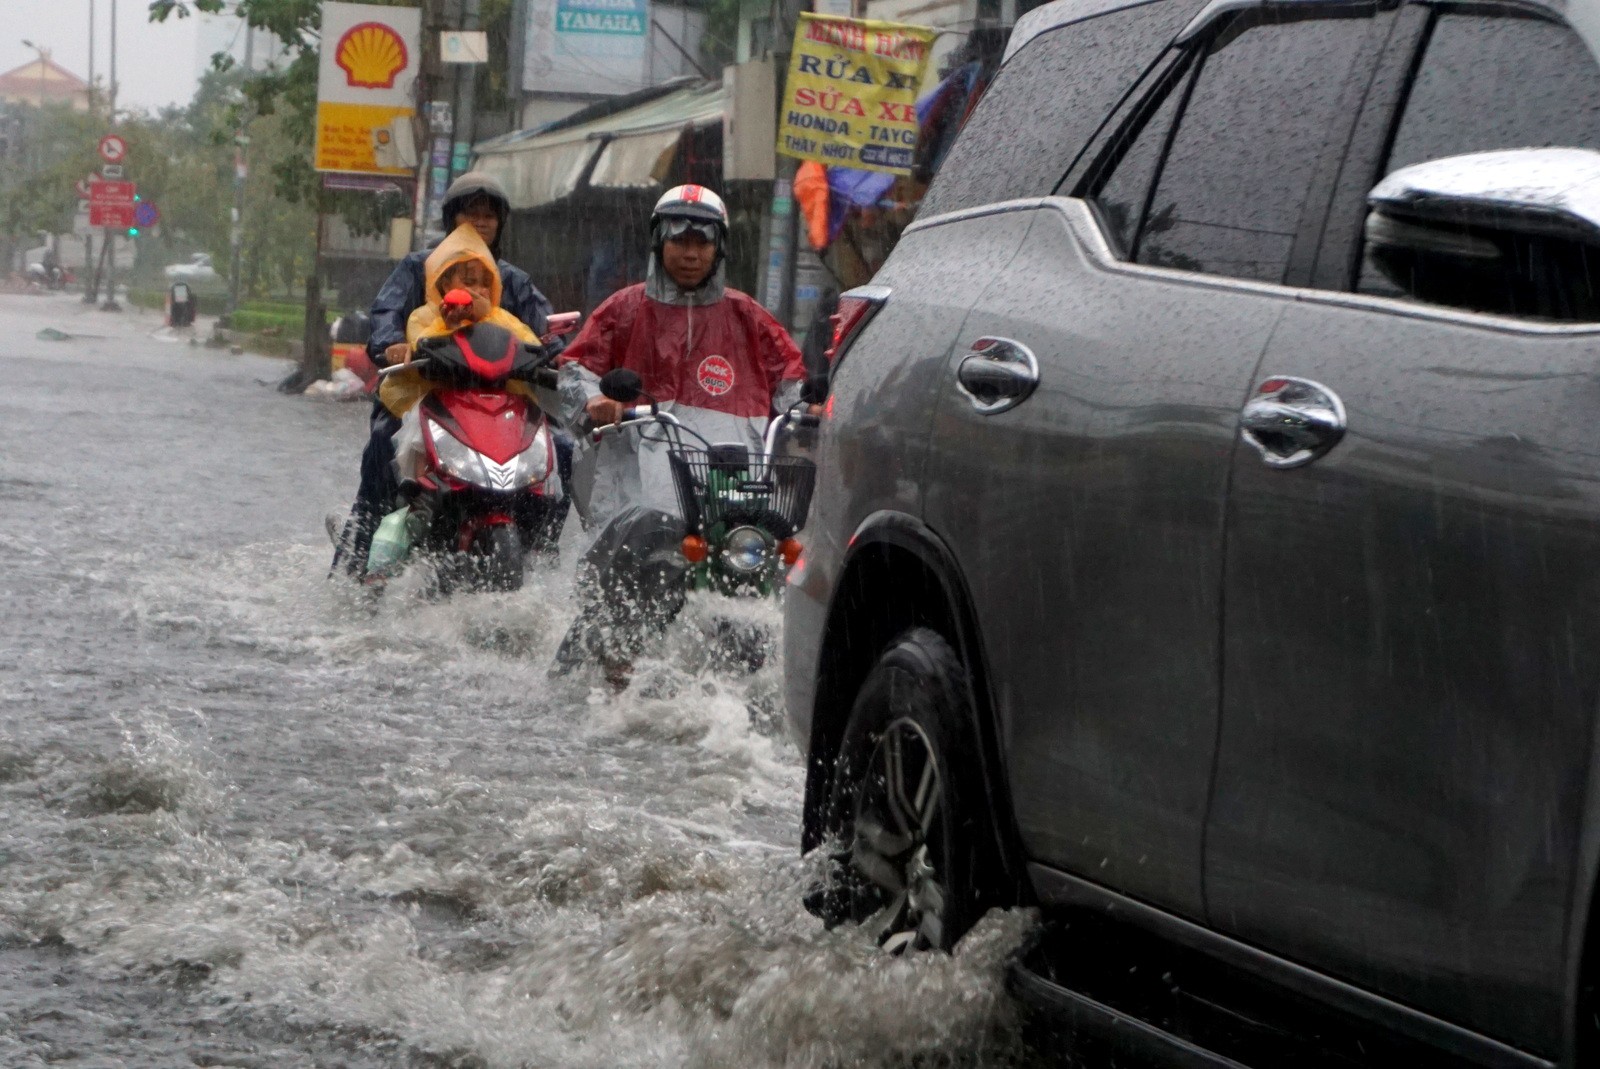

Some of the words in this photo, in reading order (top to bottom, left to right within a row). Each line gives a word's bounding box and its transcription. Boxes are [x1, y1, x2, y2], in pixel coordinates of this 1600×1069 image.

[559, 11, 641, 31] YAMAHA
[799, 53, 873, 85] RỬA
[795, 84, 865, 117] SỬA
[787, 110, 850, 136] HONDA
